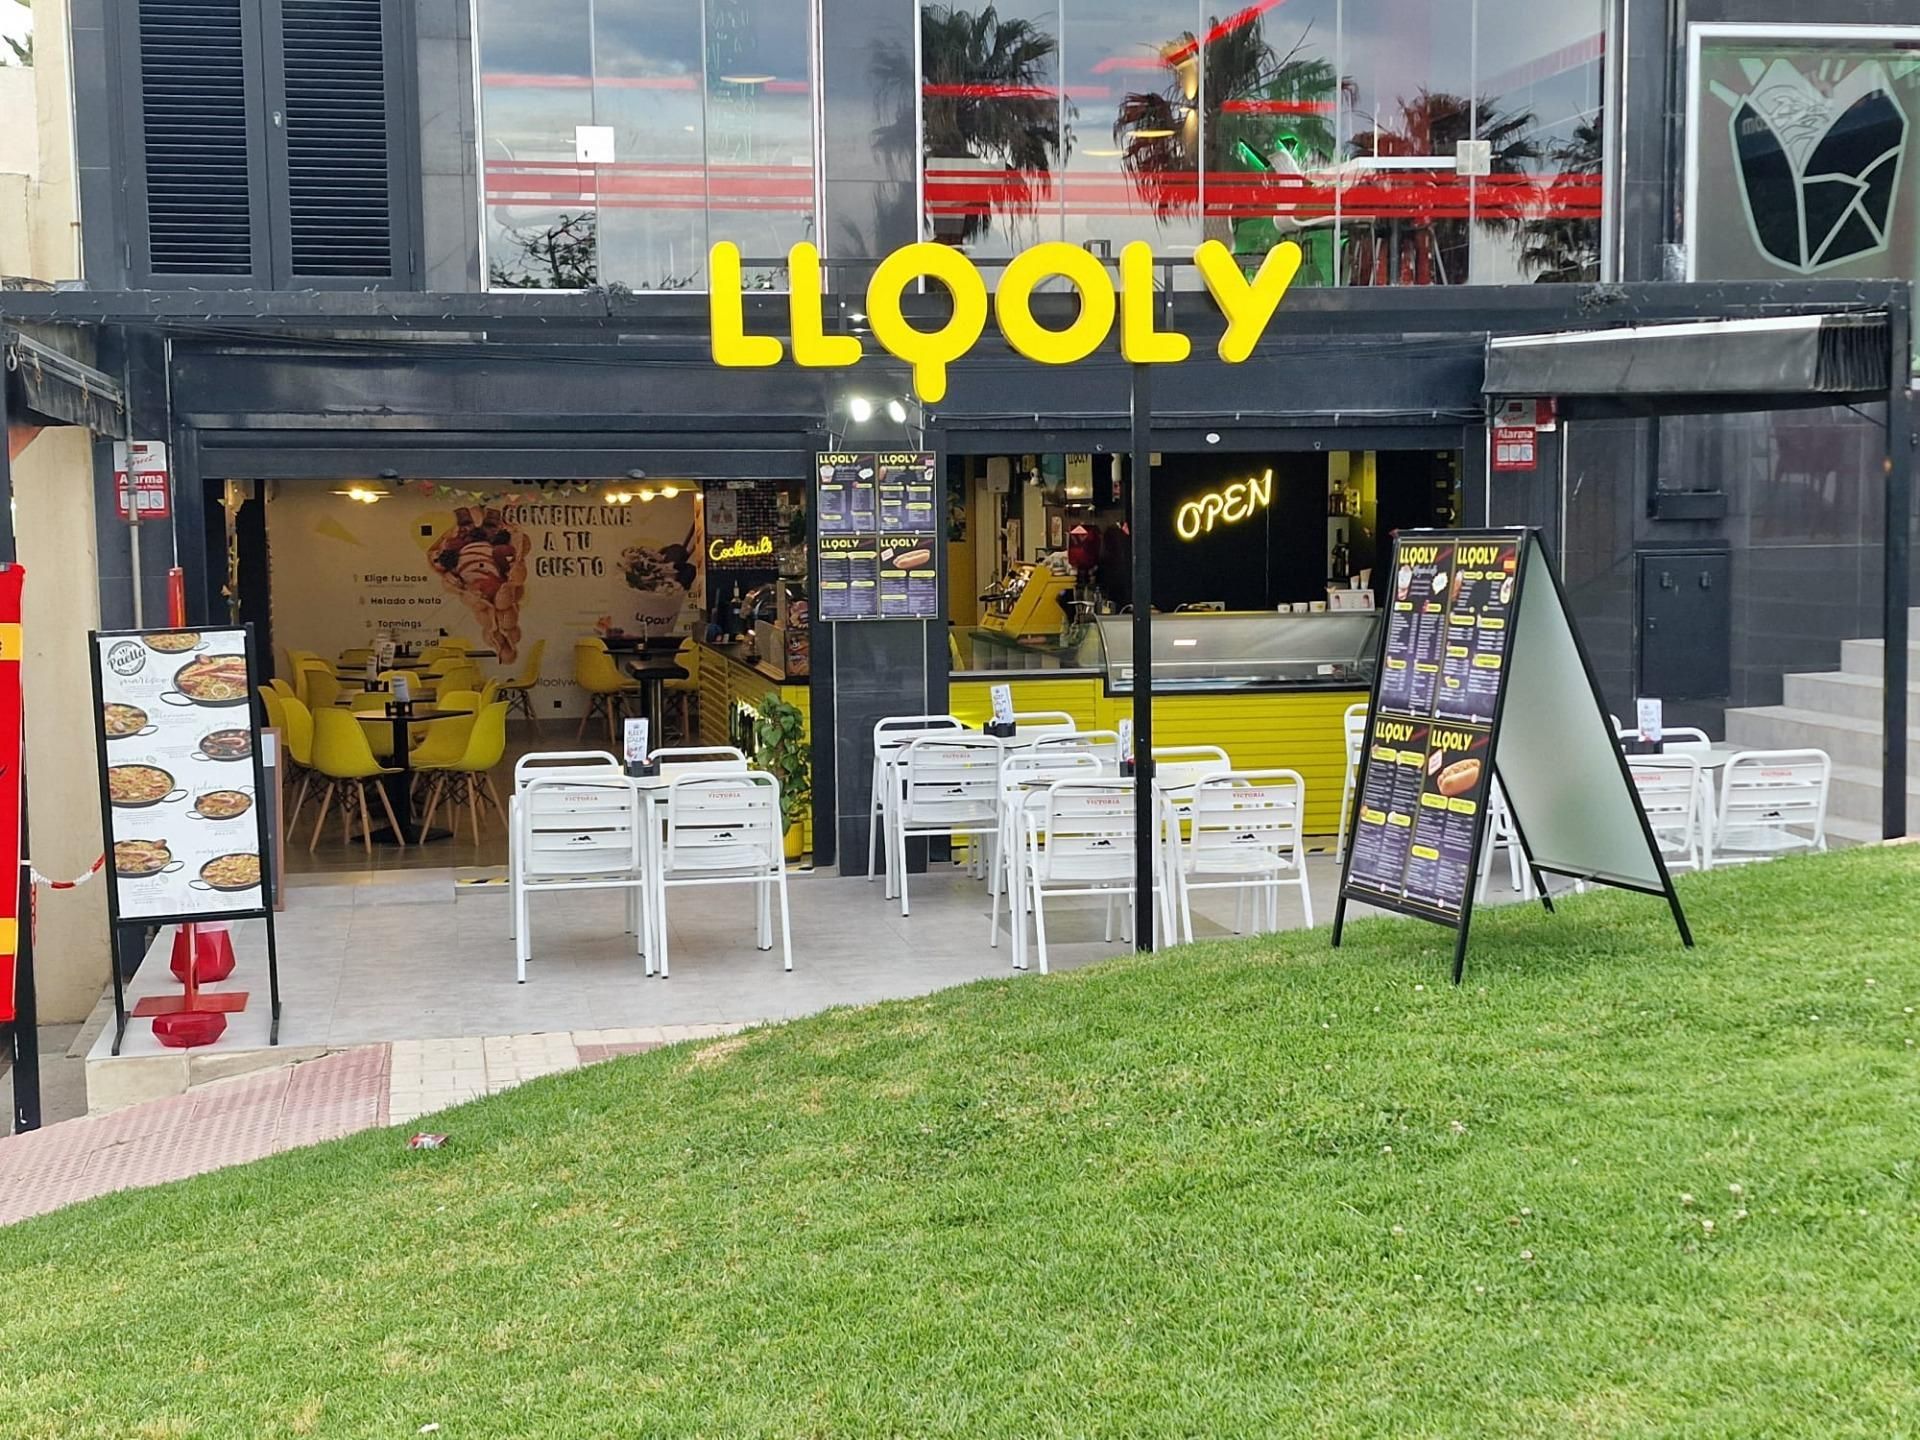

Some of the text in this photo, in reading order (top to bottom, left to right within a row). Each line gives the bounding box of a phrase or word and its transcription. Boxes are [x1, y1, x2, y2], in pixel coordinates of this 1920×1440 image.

[1498, 428, 1534, 438] Alarma
[119, 474, 164, 484] Aarma
[1175, 468, 1275, 540] OPEN
[544, 531, 593, 552] A TU
[709, 536, 773, 561] Cocktails
[536, 556, 606, 578] GUSTO
[364, 574, 388, 584] Elige
[404, 574, 428, 582] base
[371, 596, 406, 605] Helado
[418, 596, 442, 605] Nata
[107, 648, 146, 670] Paella
